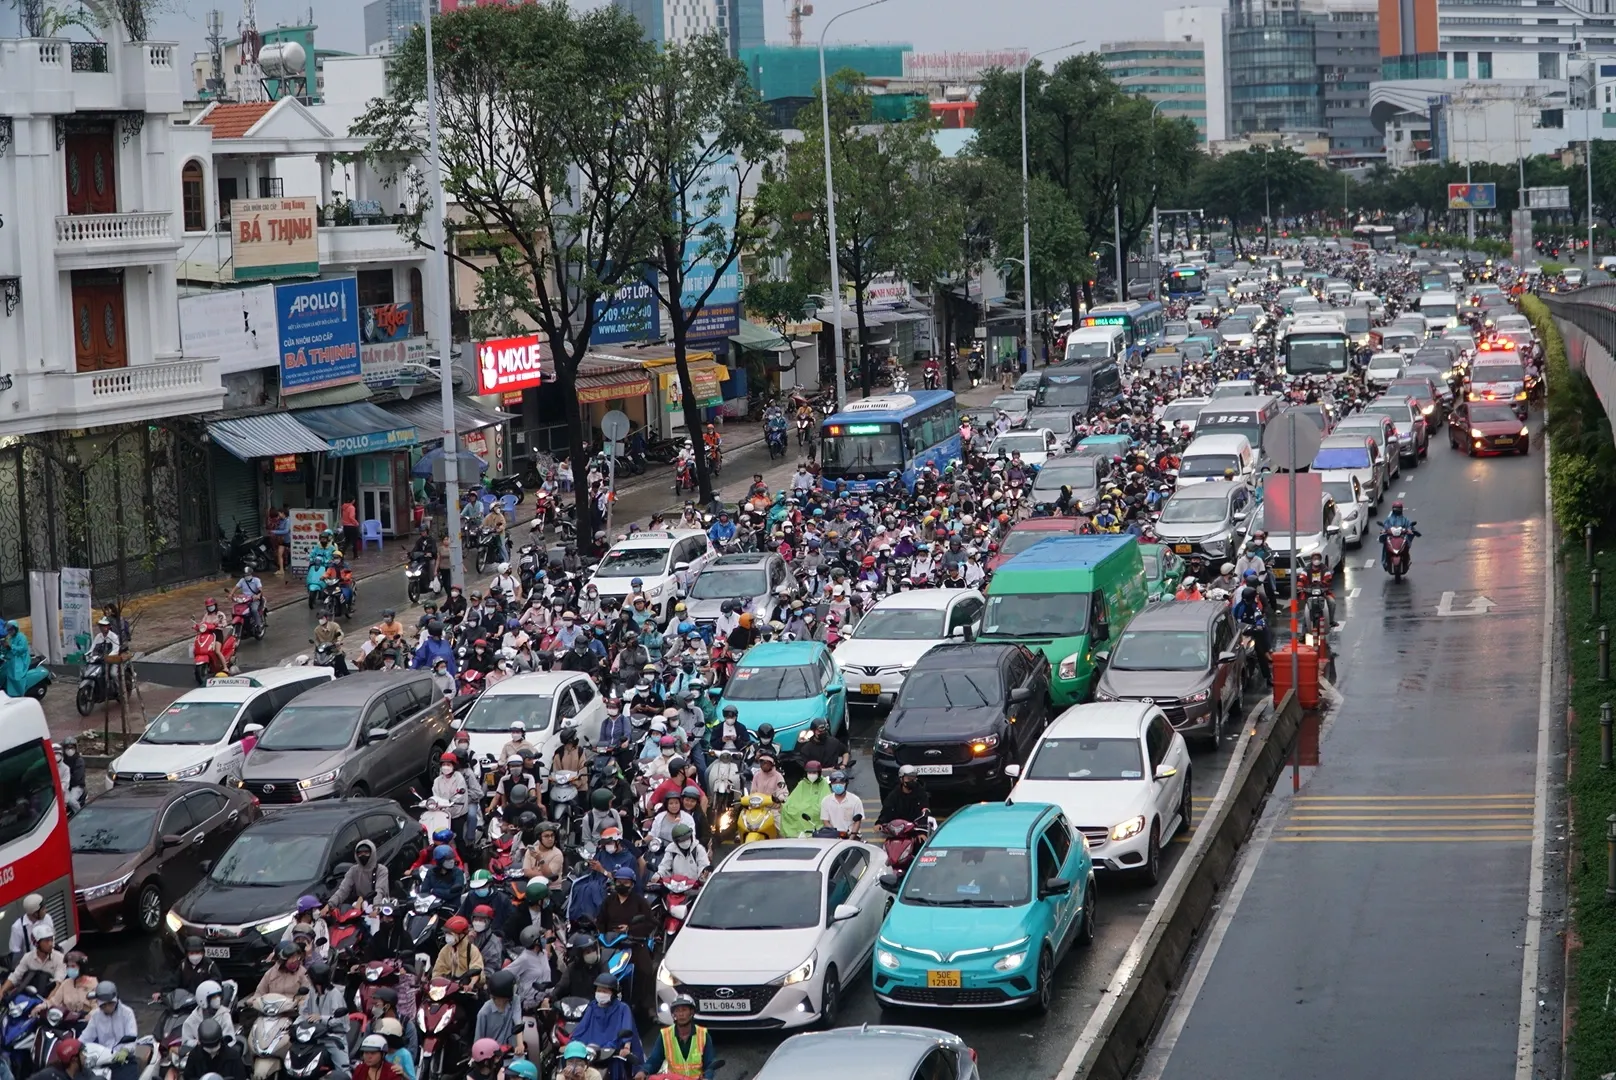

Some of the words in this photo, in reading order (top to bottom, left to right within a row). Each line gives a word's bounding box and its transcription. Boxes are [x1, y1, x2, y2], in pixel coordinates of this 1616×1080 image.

[240, 214, 262, 243] BÁ
[268, 217, 313, 246] THỊNH
[288, 291, 339, 315] APOLLO
[375, 303, 409, 336] Tiger
[284, 338, 295, 347] CỬA
[296, 336, 310, 345] NHÔM
[312, 335, 322, 343] CAO
[323, 332, 333, 341] CẤP
[285, 346, 307, 370] BÁ
[308, 342, 357, 366] THỊNH
[498, 344, 541, 374] MIXUE
[332, 435, 369, 451] APOLLO
[315, 521, 327, 532] 9
[936, 971, 952, 979] 50E
[703, 1002, 747, 1010] 51L-084.98
